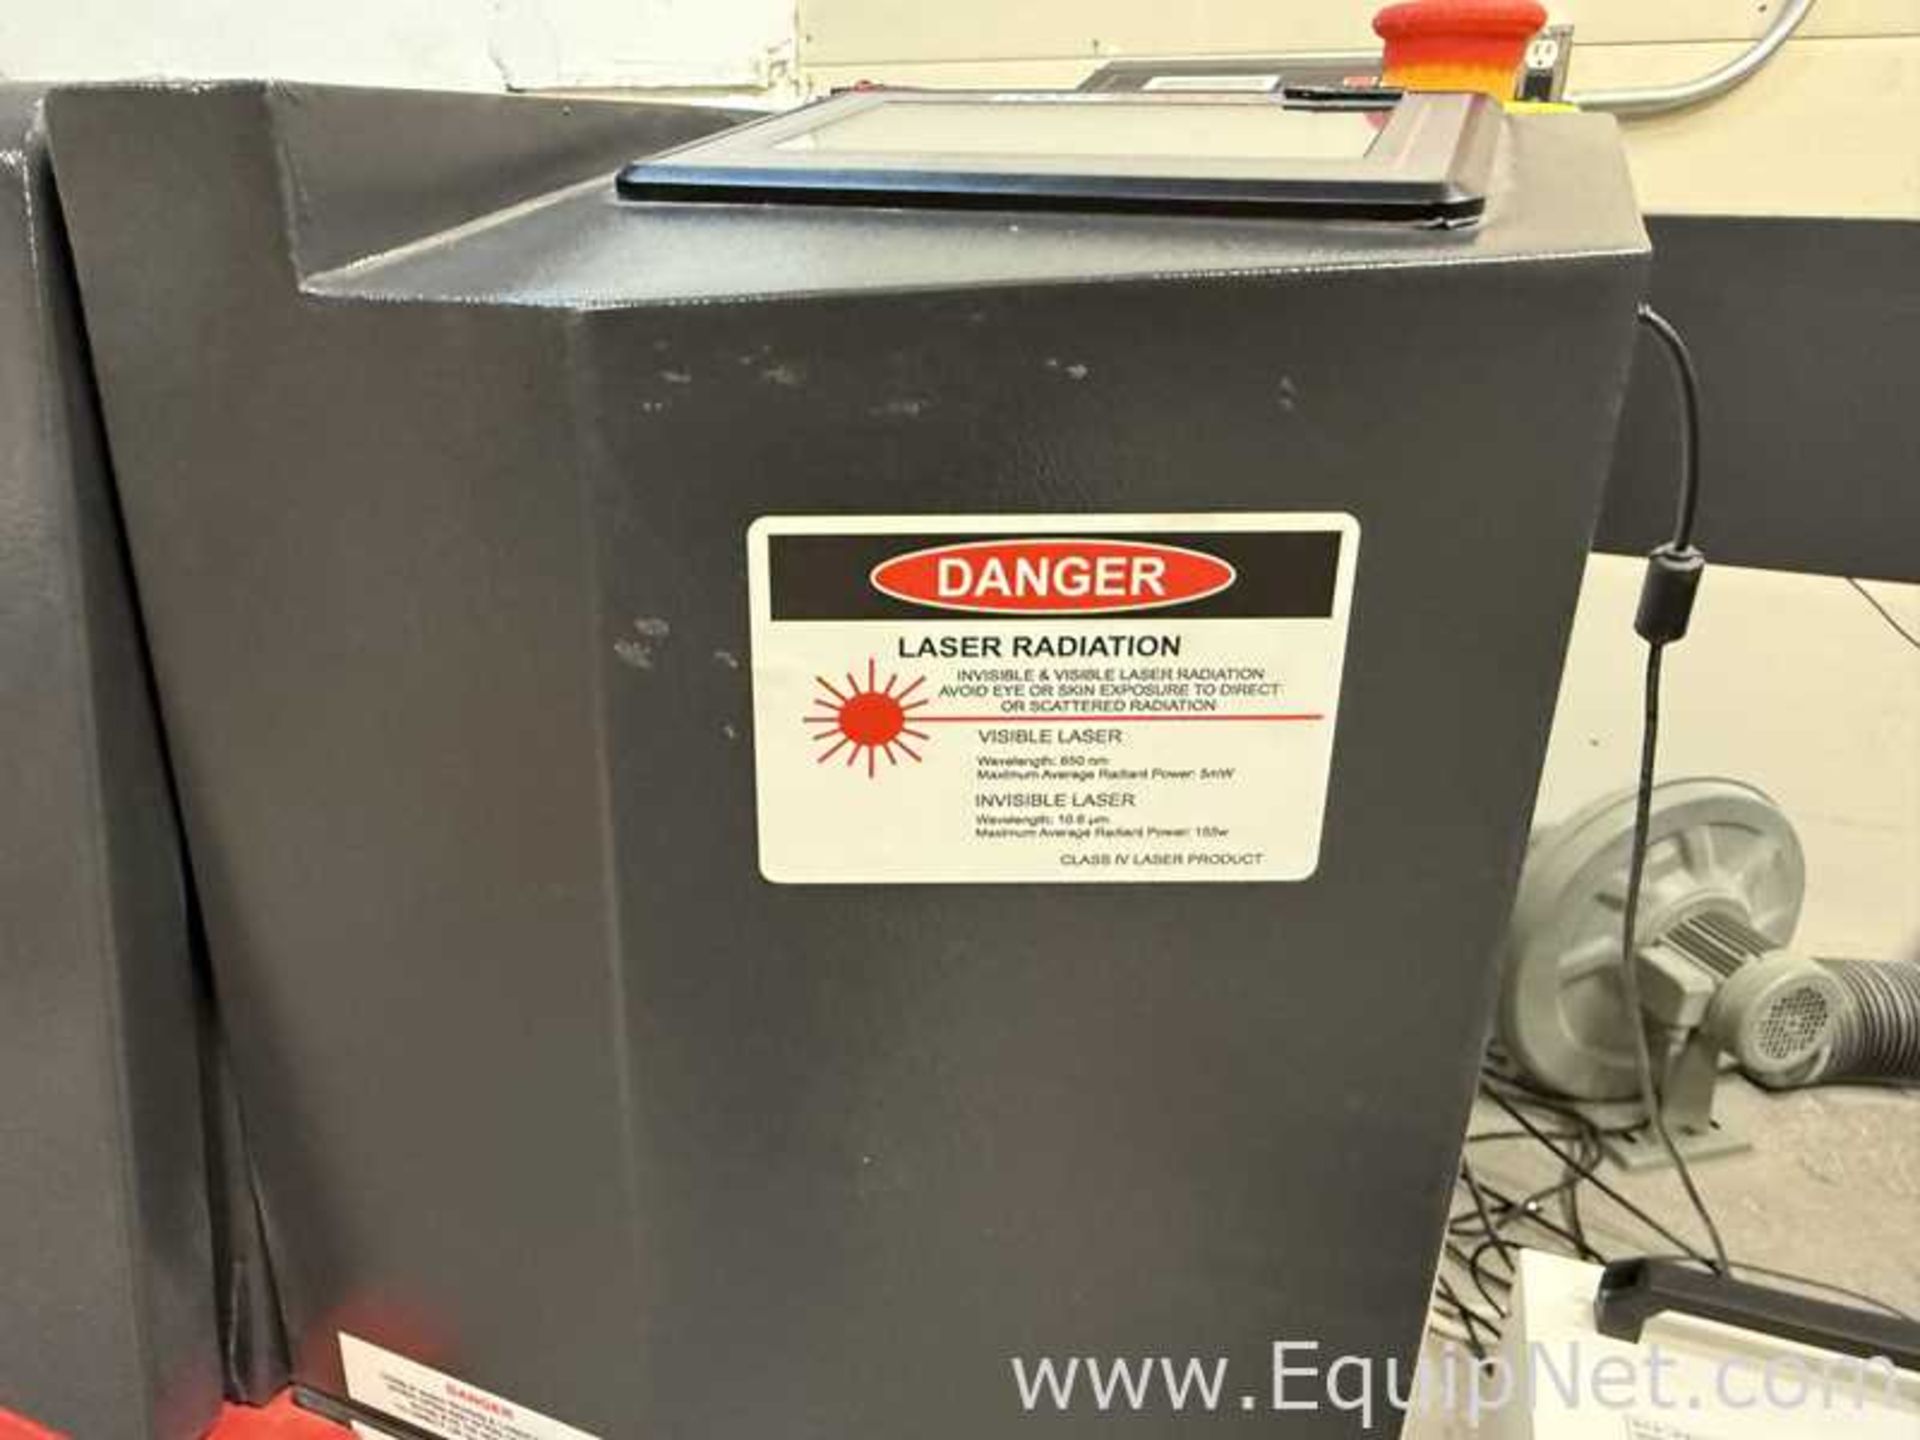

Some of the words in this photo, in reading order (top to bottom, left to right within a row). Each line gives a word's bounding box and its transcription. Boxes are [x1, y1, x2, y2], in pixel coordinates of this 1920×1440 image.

[936, 556, 1166, 598] DANGER
[898, 636, 1003, 658] LASER
[1012, 635, 1181, 657] RADIATION
[957, 670, 1034, 682] INVISIBLE
[1039, 669, 1050, 681] &
[1053, 669, 1114, 681] VISIBLE
[1119, 668, 1173, 680] LASER
[1179, 668, 1265, 680] RADIATION
[939, 685, 987, 697] AVOID
[993, 685, 1024, 696] EYE
[1029, 685, 1054, 696] OR
[1058, 685, 1096, 696] SKIN
[1100, 684, 1189, 696] EXPOSURE
[1194, 684, 1216, 695] TO
[1220, 684, 1281, 696] DIRECT
[1001, 700, 1025, 712] OR
[1029, 700, 1126, 711] SCATTERED
[1130, 699, 1217, 711] RADIATION
[979, 730, 1052, 744] VISIBLE
[1057, 729, 1122, 743] LASER
[978, 755, 1057, 768] Wavelength:
[977, 769, 1039, 780] Maximum
[1041, 769, 1094, 781] Average
[1098, 768, 1147, 780] Radiant
[976, 793, 1067, 807] INVISIBLE
[1072, 792, 1136, 807] LASER
[1039, 827, 1090, 839] Average
[1060, 853, 1111, 865] CLASS
[1115, 854, 1129, 865] IV
[1133, 853, 1183, 865] LASER
[1187, 853, 1265, 865] PRODUCT
